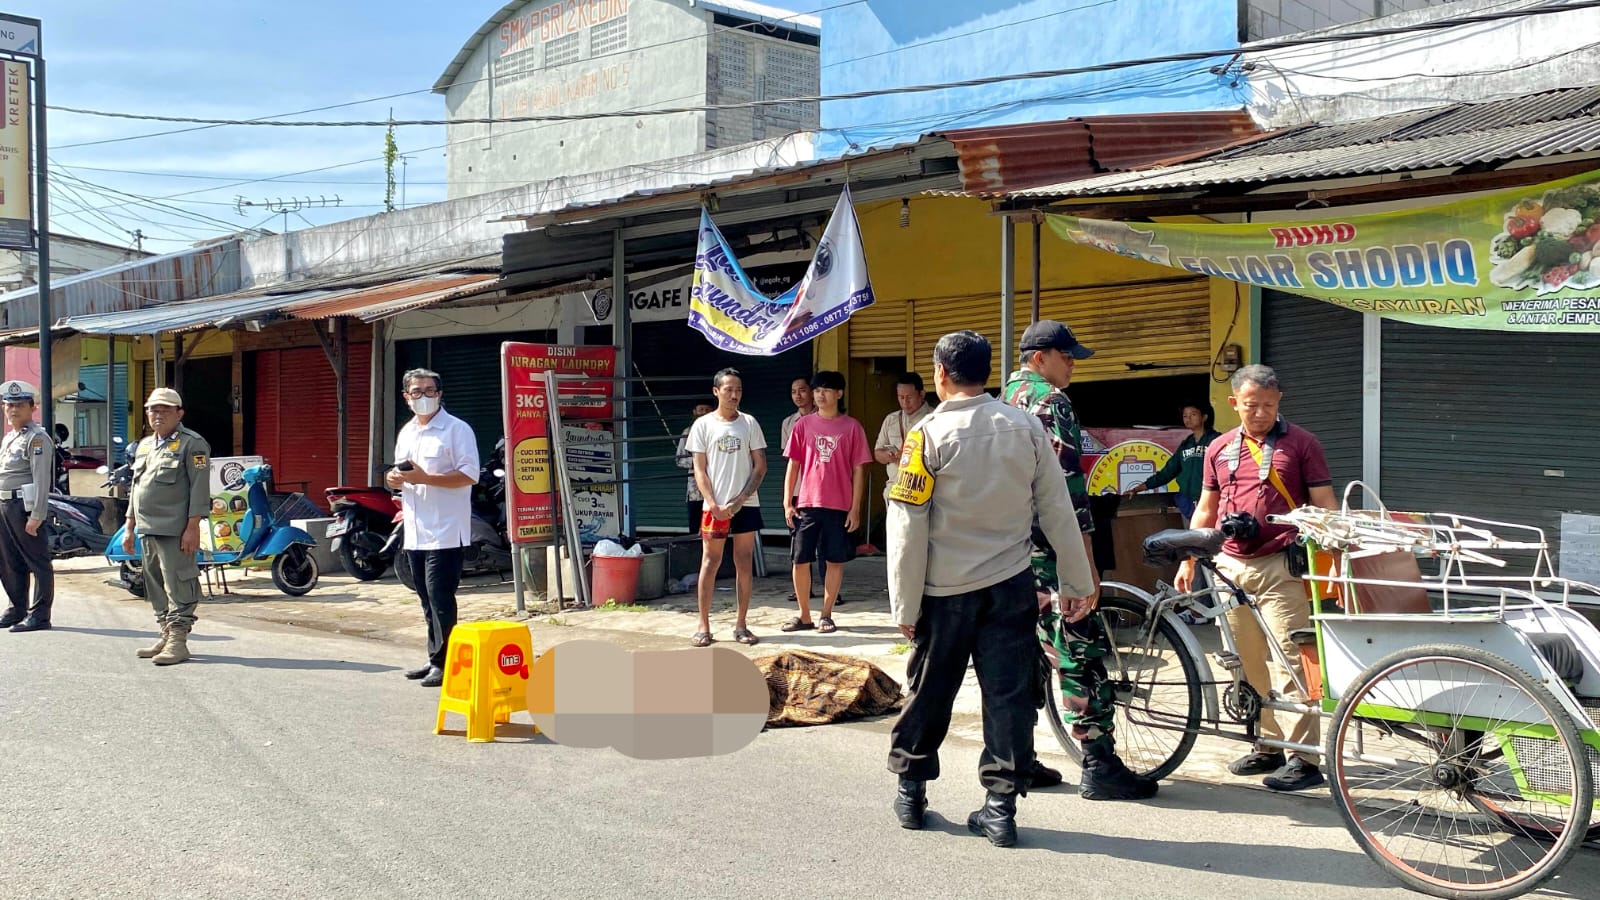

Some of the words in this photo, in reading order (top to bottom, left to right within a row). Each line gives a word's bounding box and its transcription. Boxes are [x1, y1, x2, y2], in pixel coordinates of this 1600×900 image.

[500, 15, 528, 55] SMK
[9, 68, 19, 126] KRETEK
[1307, 238, 1479, 290] SHODIQ
[1351, 297, 1487, 317] SAYURAN
[1502, 299, 1560, 311] MENERIMA
[799, 323, 819, 337] 1096
[823, 309, 843, 325] 0877
[1516, 312, 1556, 324] ANTAR
[547, 346, 577, 357] DISINI
[511, 356, 558, 369] JURAGAN
[562, 360, 611, 371] LAUNDRY
[515, 393, 545, 409] 3KG
[516, 409, 541, 419] HANYA
[1122, 445, 1151, 454] FAST
[1092, 455, 1113, 489] FRESH
